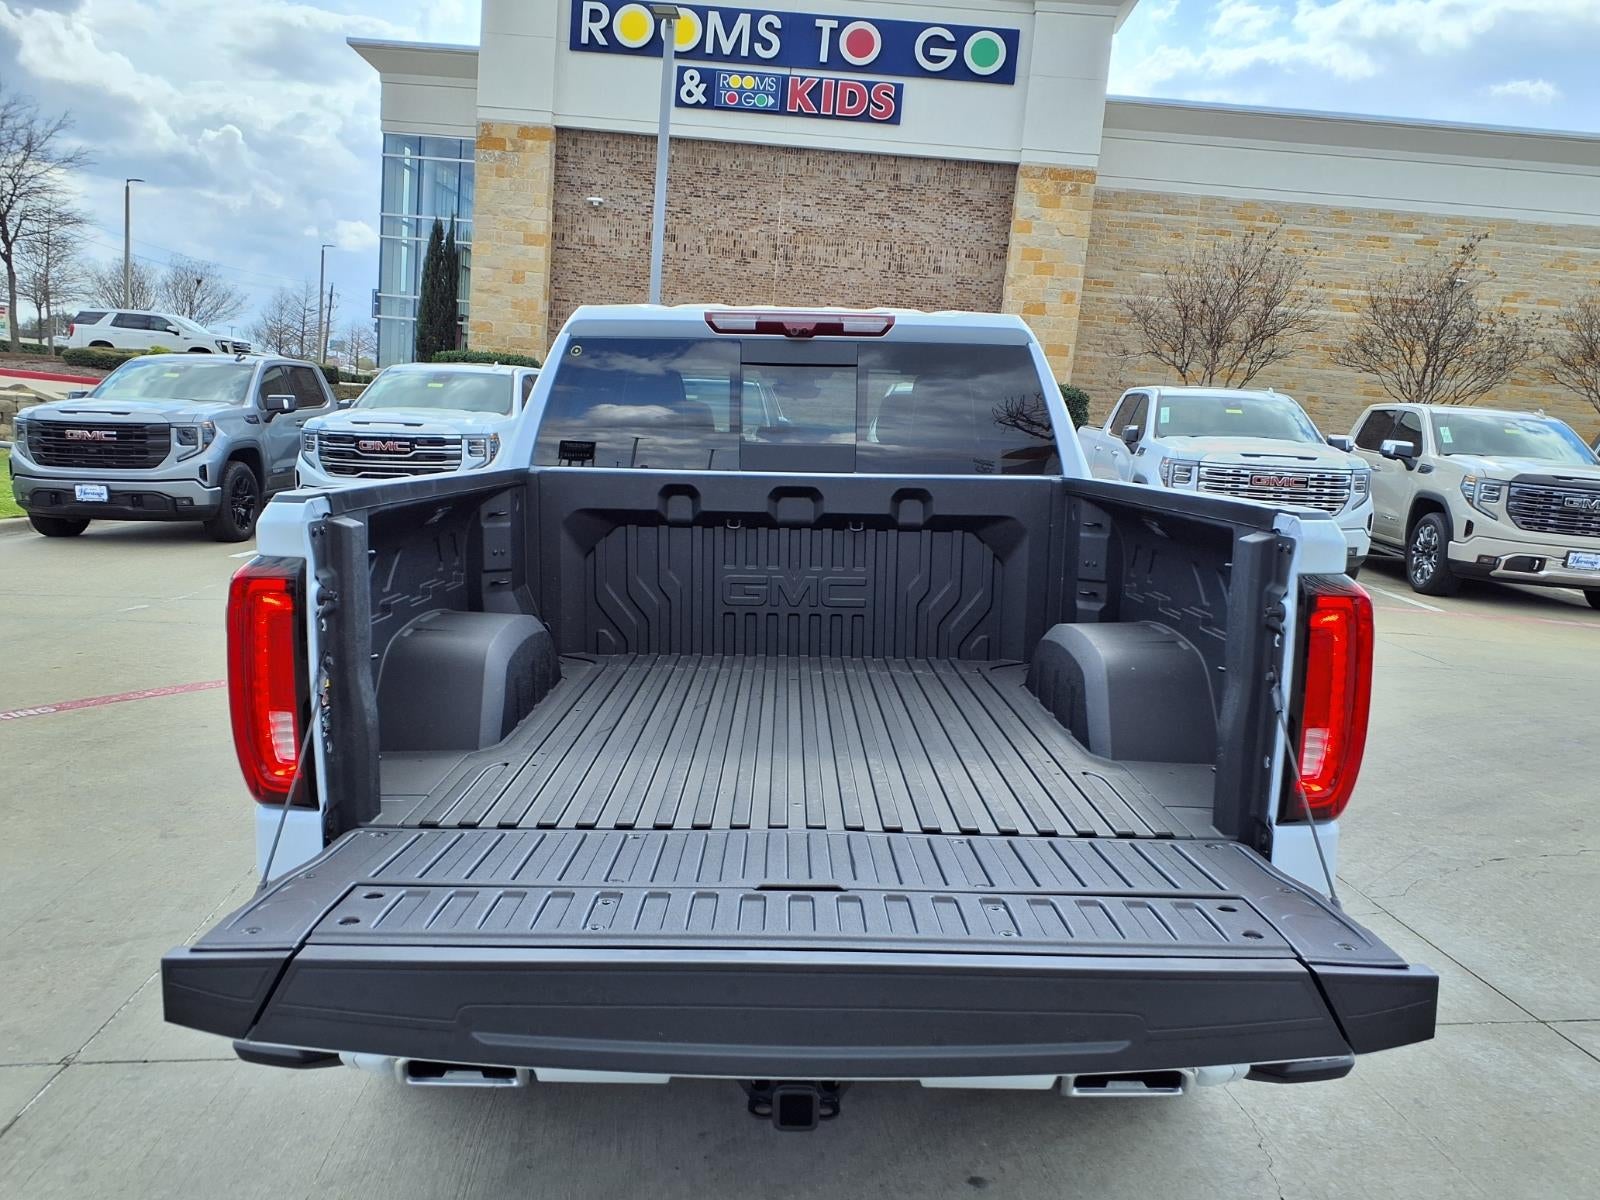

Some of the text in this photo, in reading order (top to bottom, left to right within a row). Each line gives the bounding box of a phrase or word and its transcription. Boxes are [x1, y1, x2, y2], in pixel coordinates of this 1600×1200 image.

[581, 1, 1007, 75] ROOMS TO GO
[679, 68, 707, 105] &
[719, 74, 776, 92] ROOMS
[720, 90, 768, 107] TO GO
[787, 76, 895, 120] KIDS
[65, 429, 117, 441] GMC
[358, 440, 411, 452] GMC
[1251, 475, 1308, 488] GMC
[722, 575, 867, 608] GMC
